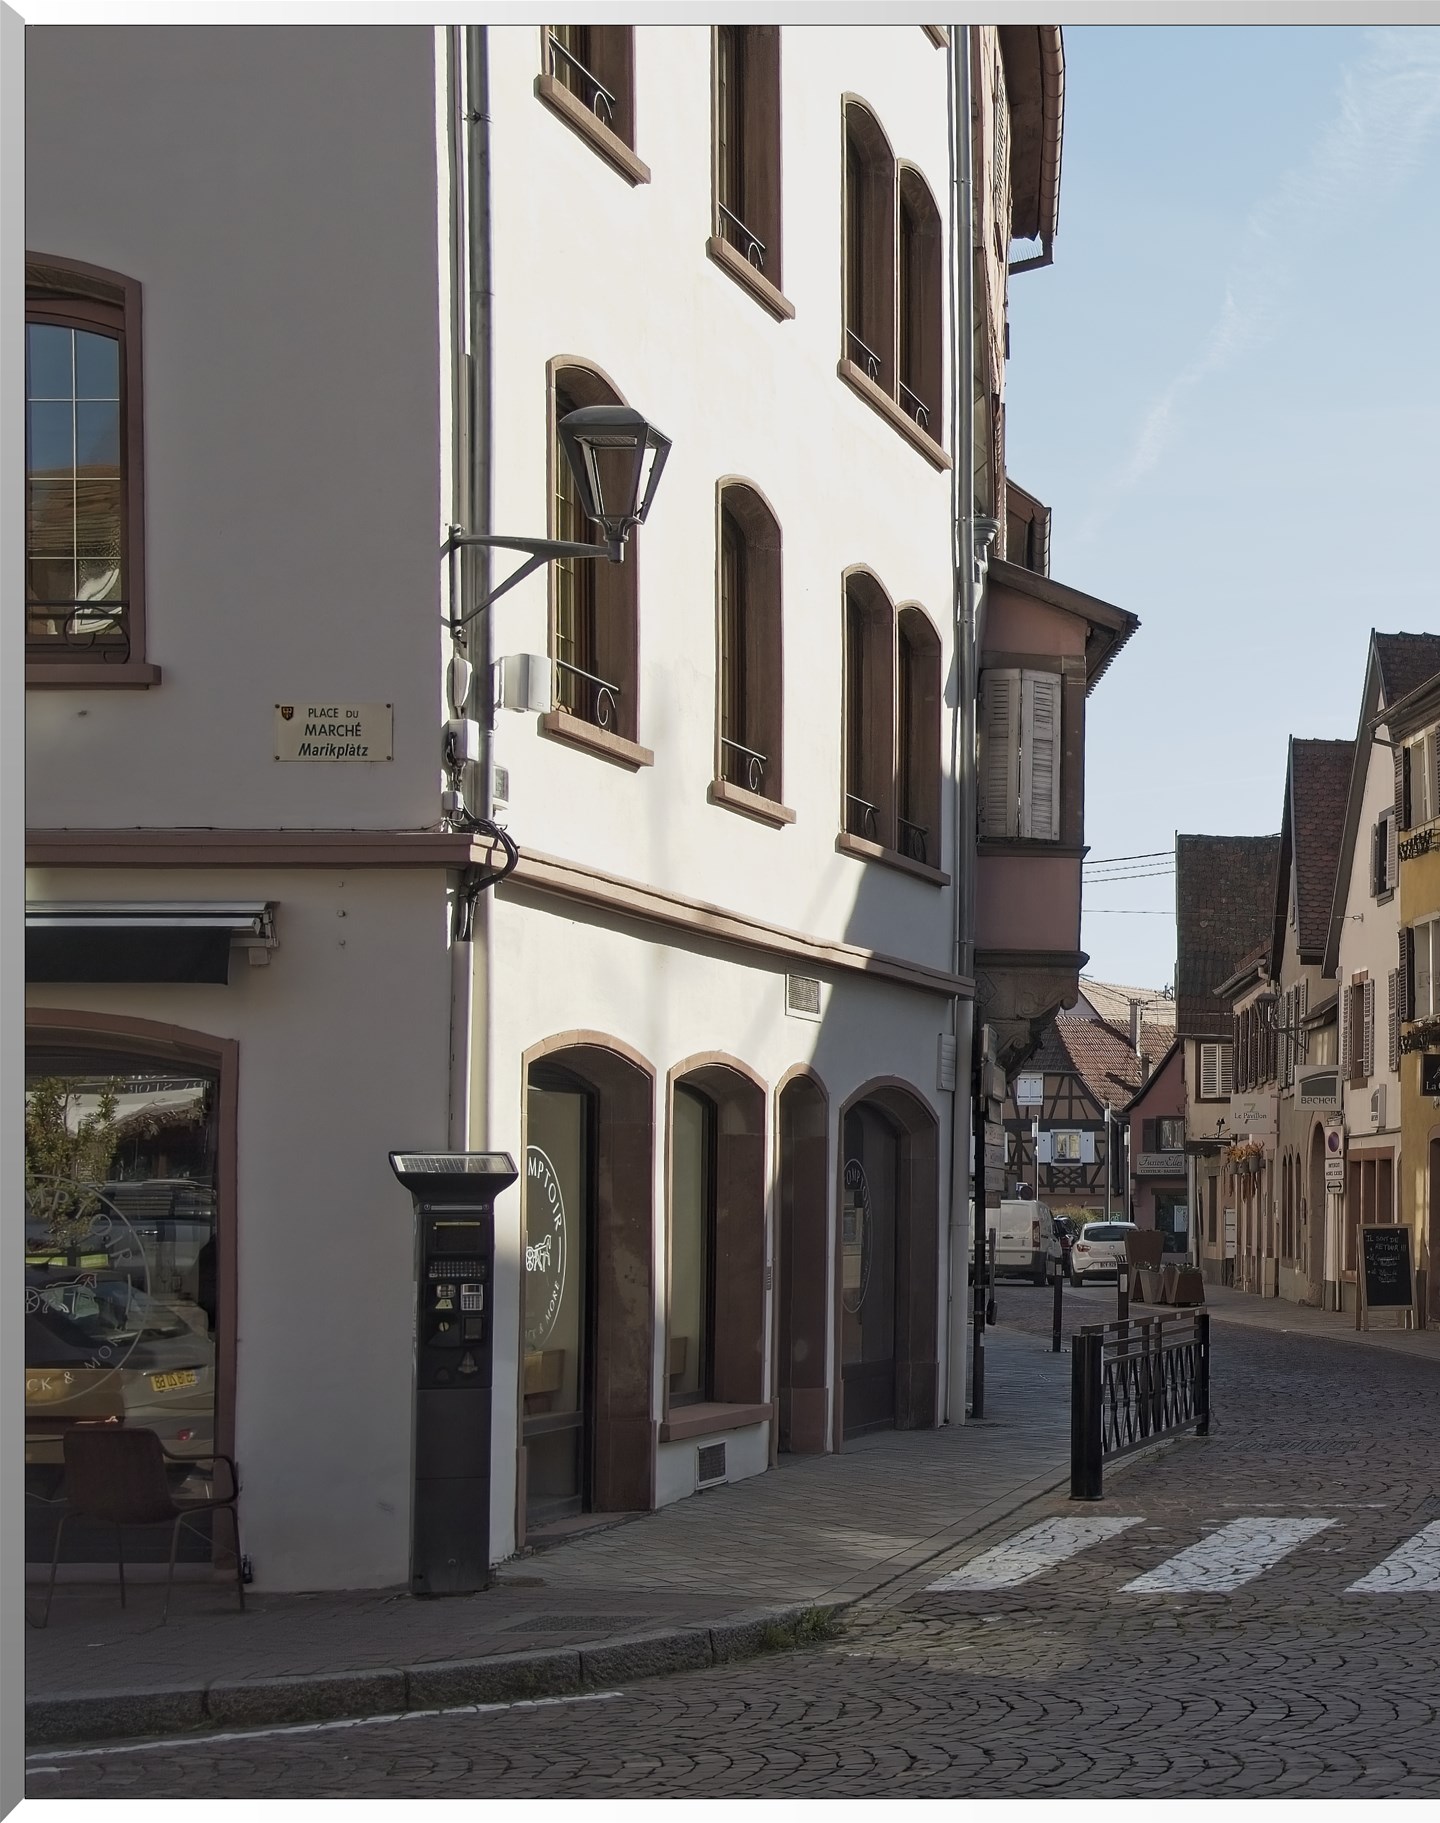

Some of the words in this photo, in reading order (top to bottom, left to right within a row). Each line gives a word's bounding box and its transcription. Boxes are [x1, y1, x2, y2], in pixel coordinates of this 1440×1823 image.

[308, 708, 339, 718] PLACE
[346, 710, 359, 718] DU
[304, 722, 361, 737] MARCHÉ
[298, 743, 369, 759] Marikplàtz
[1426, 1081, 1437, 1091] La
